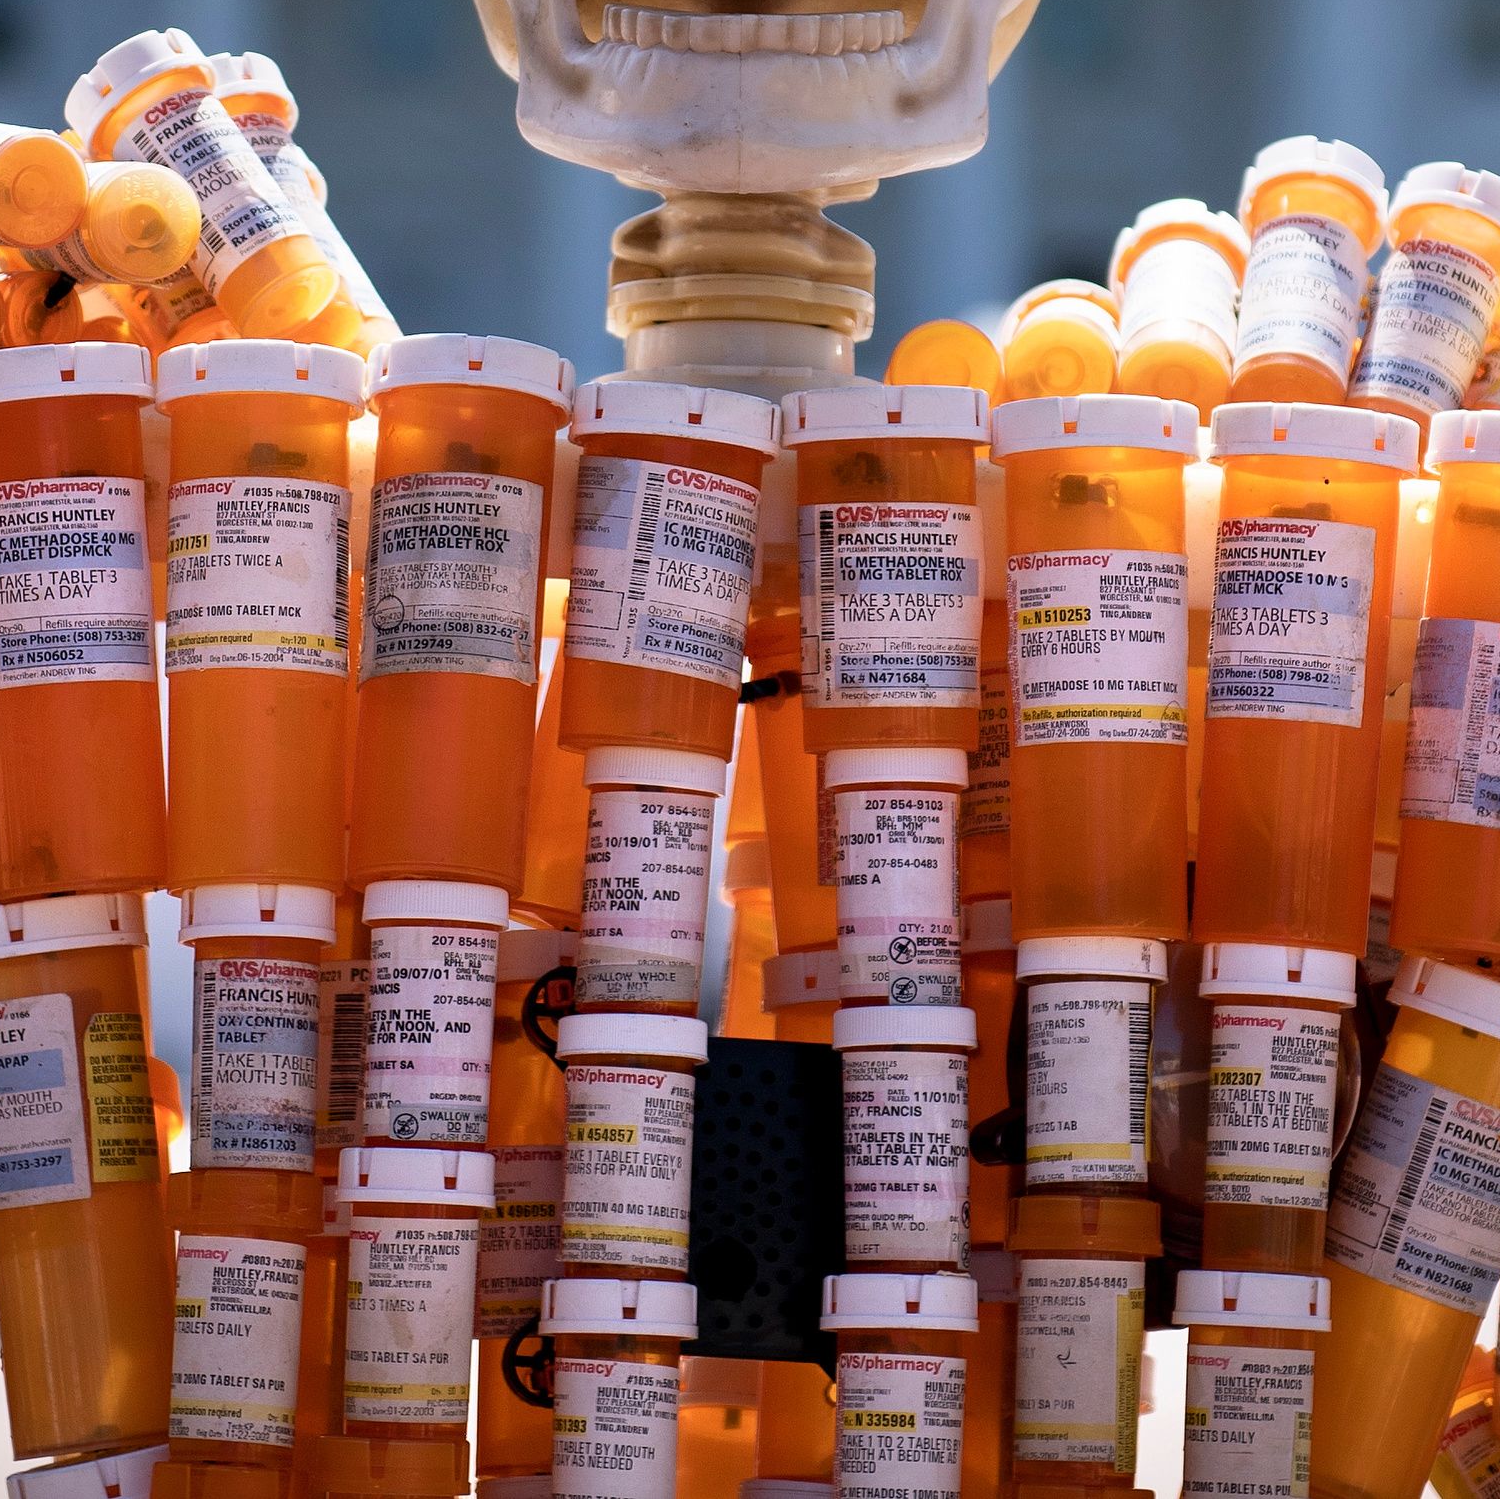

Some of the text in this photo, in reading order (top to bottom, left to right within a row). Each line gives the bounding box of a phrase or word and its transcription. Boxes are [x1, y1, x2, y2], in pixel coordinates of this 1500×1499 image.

[183, 142, 222, 167] TABLET
[189, 160, 225, 189] TAKE
[222, 211, 250, 234] Store
[231, 234, 248, 248] Rx
[384, 474, 492, 495] CVS/pharmacy
[115, 487, 131, 497] 0166
[52, 509, 115, 523] HUNTLEY
[383, 502, 500, 521] FRANCIS HUNTLEY
[666, 499, 724, 521] FRANCIS
[836, 507, 948, 522] CVS/pharmacy
[396, 524, 510, 542] METHADONE HCL
[1221, 519, 1316, 538] CVS/pharmacy
[10, 532, 99, 550] METHADOSE
[102, 533, 116, 545] 40
[119, 533, 135, 545] MG
[396, 538, 504, 554] MG TABLET ROX
[682, 538, 706, 554] MG
[838, 533, 958, 546] FRANCIS HUNTLEY
[49, 544, 112, 559] DISPMCK
[1260, 549, 1326, 562] HUNTLEY
[190, 555, 271, 568] TABLETS TWICE
[658, 557, 695, 578] TAKE
[840, 556, 966, 570] IC METHADONE HCL
[1008, 555, 1110, 571] CVS/pharmacy
[49, 570, 106, 585] TABLET
[186, 568, 207, 582] PAIN
[841, 569, 962, 581] 10 MG TABLET ROX
[1228, 570, 1303, 584] METHADOSE
[44, 586, 55, 600] A
[60, 584, 94, 599] DAY
[656, 572, 740, 604] TIMES DAY
[1218, 583, 1284, 596] TABLET MCK
[840, 594, 955, 608] TAKE TABLETS
[207, 605, 302, 618] 10MG TABLET MCK
[840, 608, 936, 622] TIMES A DAY
[1045, 608, 1091, 622] 510253
[1252, 607, 1316, 624] TABLETS
[46, 618, 105, 629] Refills require
[1259, 623, 1292, 636] DAY
[1, 631, 102, 649] Store Phone: (508)
[220, 634, 252, 644] required
[1021, 629, 1165, 645] TAKE TABLETS BY MOUTH
[398, 639, 453, 651] N129749
[1021, 642, 1101, 659] EVERY HOURS
[2, 649, 84, 666] Rx N506052
[841, 654, 943, 666] Store Phone: (508)
[40, 667, 96, 677] ANDREW TING
[869, 673, 926, 684] N471684
[1258, 670, 1287, 681] (508)
[1031, 680, 1161, 693] METHADOSE MG TABLET
[1226, 685, 1274, 697] N560322
[641, 804, 664, 814] 207
[865, 800, 943, 810] 207 854-9103
[605, 836, 658, 849] 10/19/01
[868, 858, 938, 869] 207-854-0483
[606, 889, 680, 901] NOON, AND
[610, 900, 640, 911] PAIN
[899, 923, 924, 933] QTY:
[432, 936, 454, 946] 207
[917, 937, 948, 947] BEFORE
[393, 968, 450, 980] 09/07/01
[219, 989, 283, 1003] FRANCIS
[395, 1021, 471, 1033] NOON, AND
[217, 1032, 266, 1043] TABLET
[400, 1033, 432, 1044] PAIN
[1220, 1072, 1261, 1086] 282307
[914, 1091, 961, 1104] 11/01/01
[1229, 1090, 1314, 1106] TABLETS IN THE
[420, 1111, 471, 1122] SWALLOW
[867, 1106, 922, 1116] FRANCIS
[1293, 1106, 1329, 1120] EVENING
[1292, 1119, 1329, 1133] BEDTIME
[587, 1129, 633, 1143] 454857
[854, 1132, 951, 1144] TABLETS IN THE
[877, 1143, 926, 1154] TABLET
[11, 1155, 62, 1171] 753-3297
[597, 1151, 675, 1168] TABLET EVERY
[926, 1155, 960, 1168] NIGHT
[619, 1166, 677, 1181] PAIN ONLY
[1425, 1267, 1473, 1293] N821688
[217, 1322, 252, 1337] DAILY
[210, 1374, 249, 1388] TABLET
[866, 1413, 915, 1427] 335984
[1221, 1431, 1255, 1444] DAILY
[615, 1444, 655, 1460] MOUTH
[899, 1450, 945, 1464] BEDTIME
[588, 1456, 633, 1470] NEEDED
